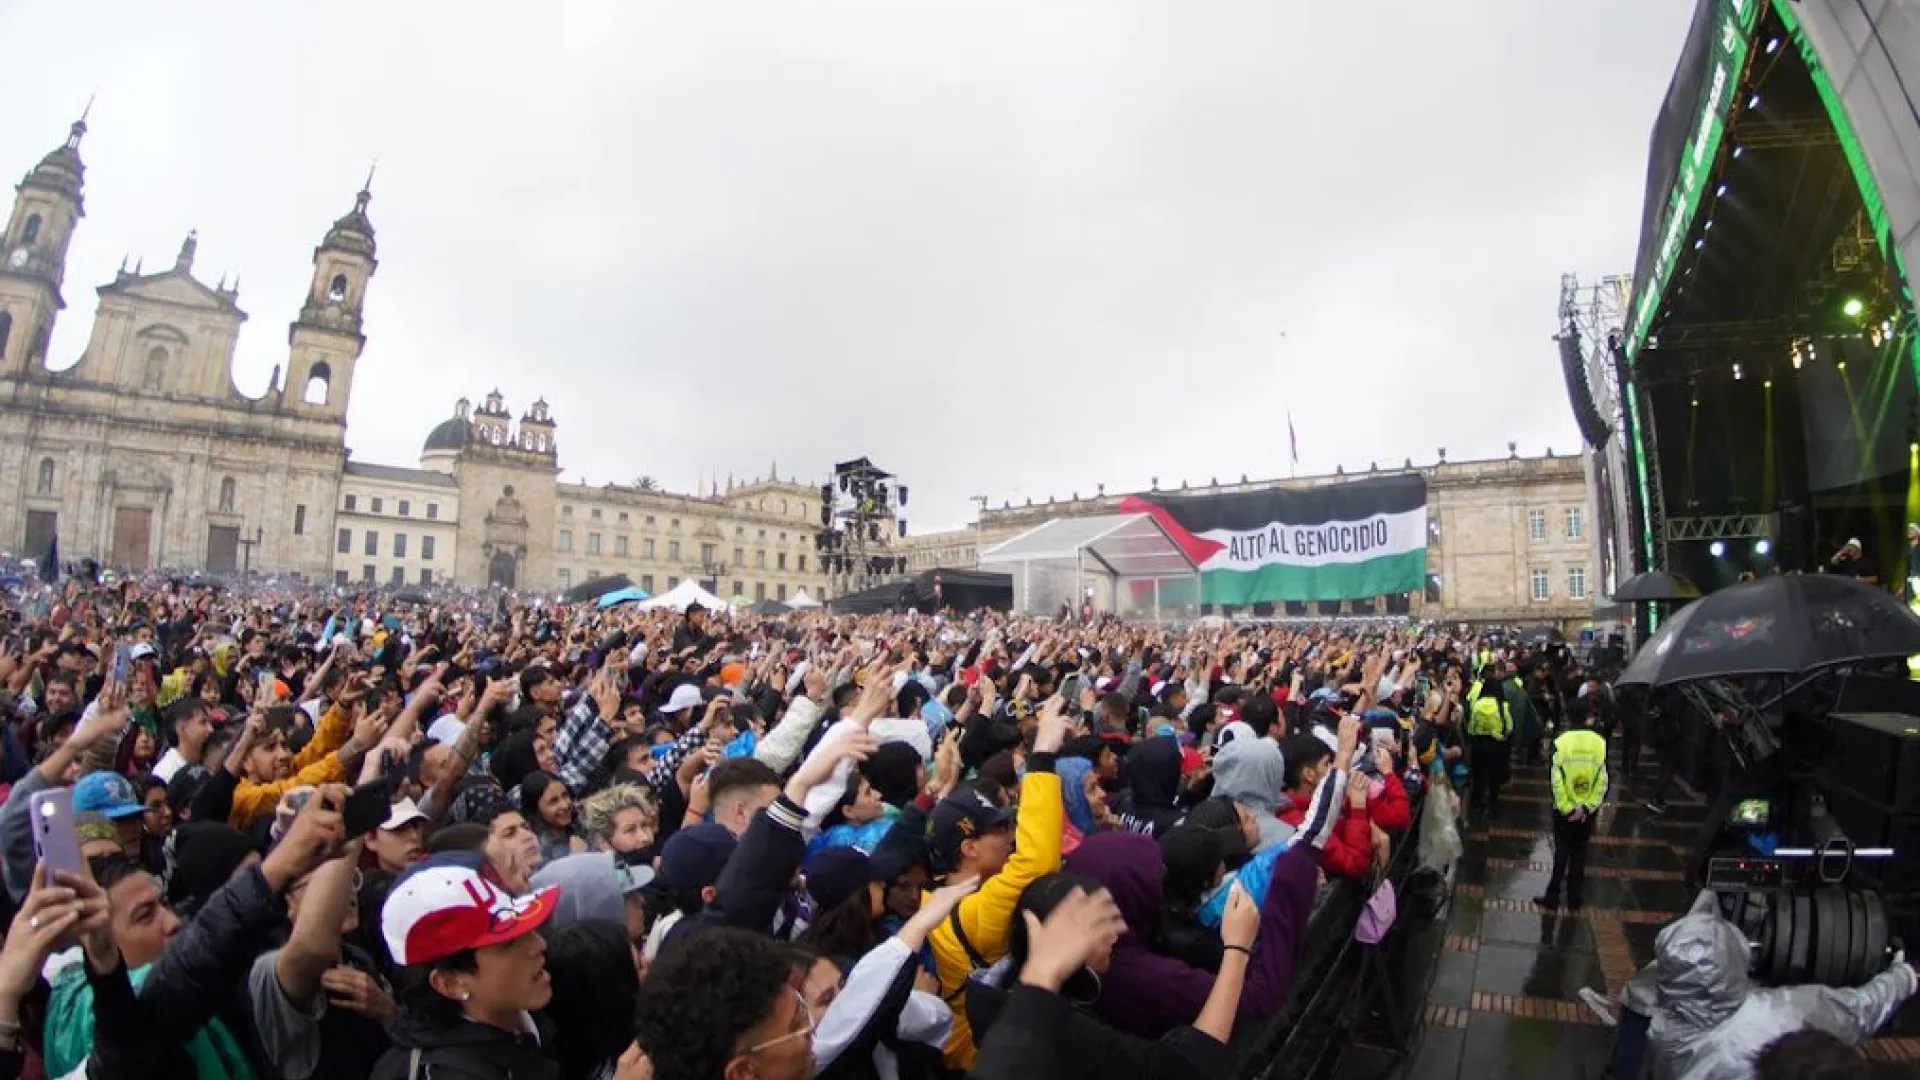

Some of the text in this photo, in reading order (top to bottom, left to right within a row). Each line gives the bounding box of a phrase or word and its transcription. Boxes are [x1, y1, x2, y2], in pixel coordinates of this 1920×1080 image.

[1229, 518, 1387, 561] ALTO AL GENOCIDIO
